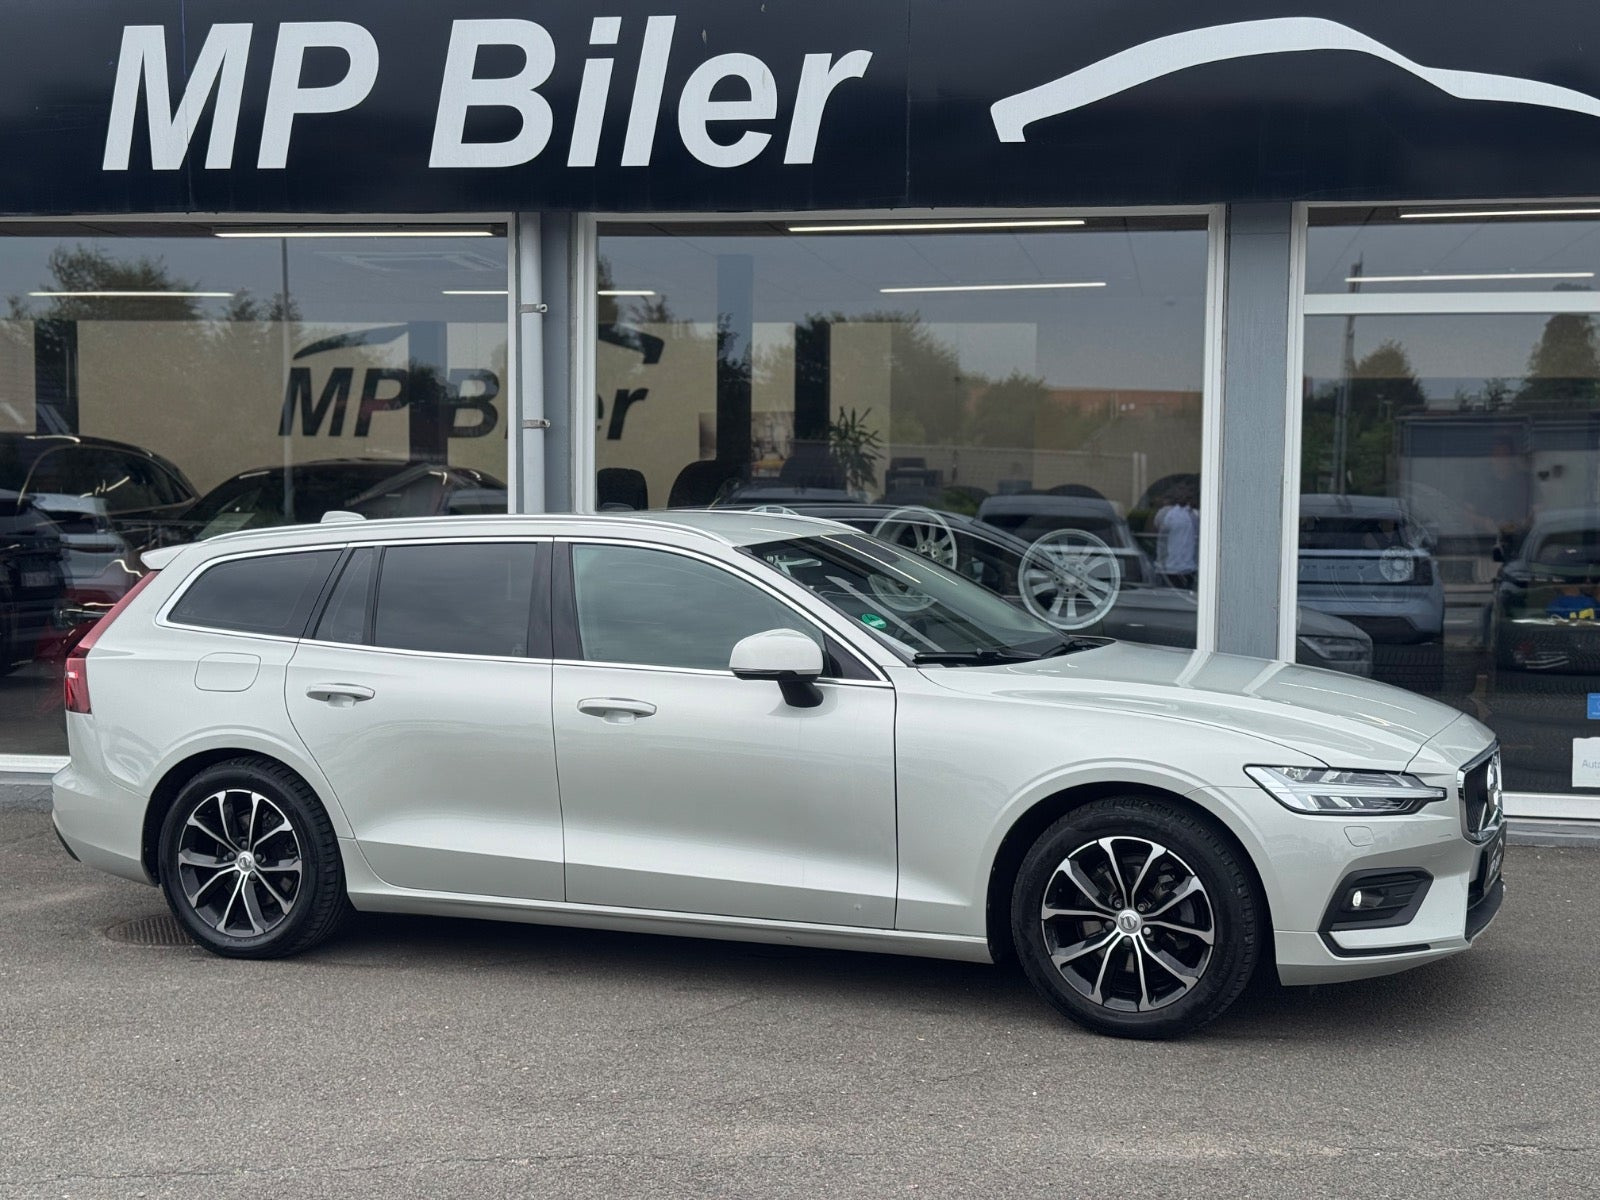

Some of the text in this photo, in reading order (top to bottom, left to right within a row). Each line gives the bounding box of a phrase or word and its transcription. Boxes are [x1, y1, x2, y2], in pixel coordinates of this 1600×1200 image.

[103, 16, 873, 170] MP Biler
[278, 367, 410, 437] MP
